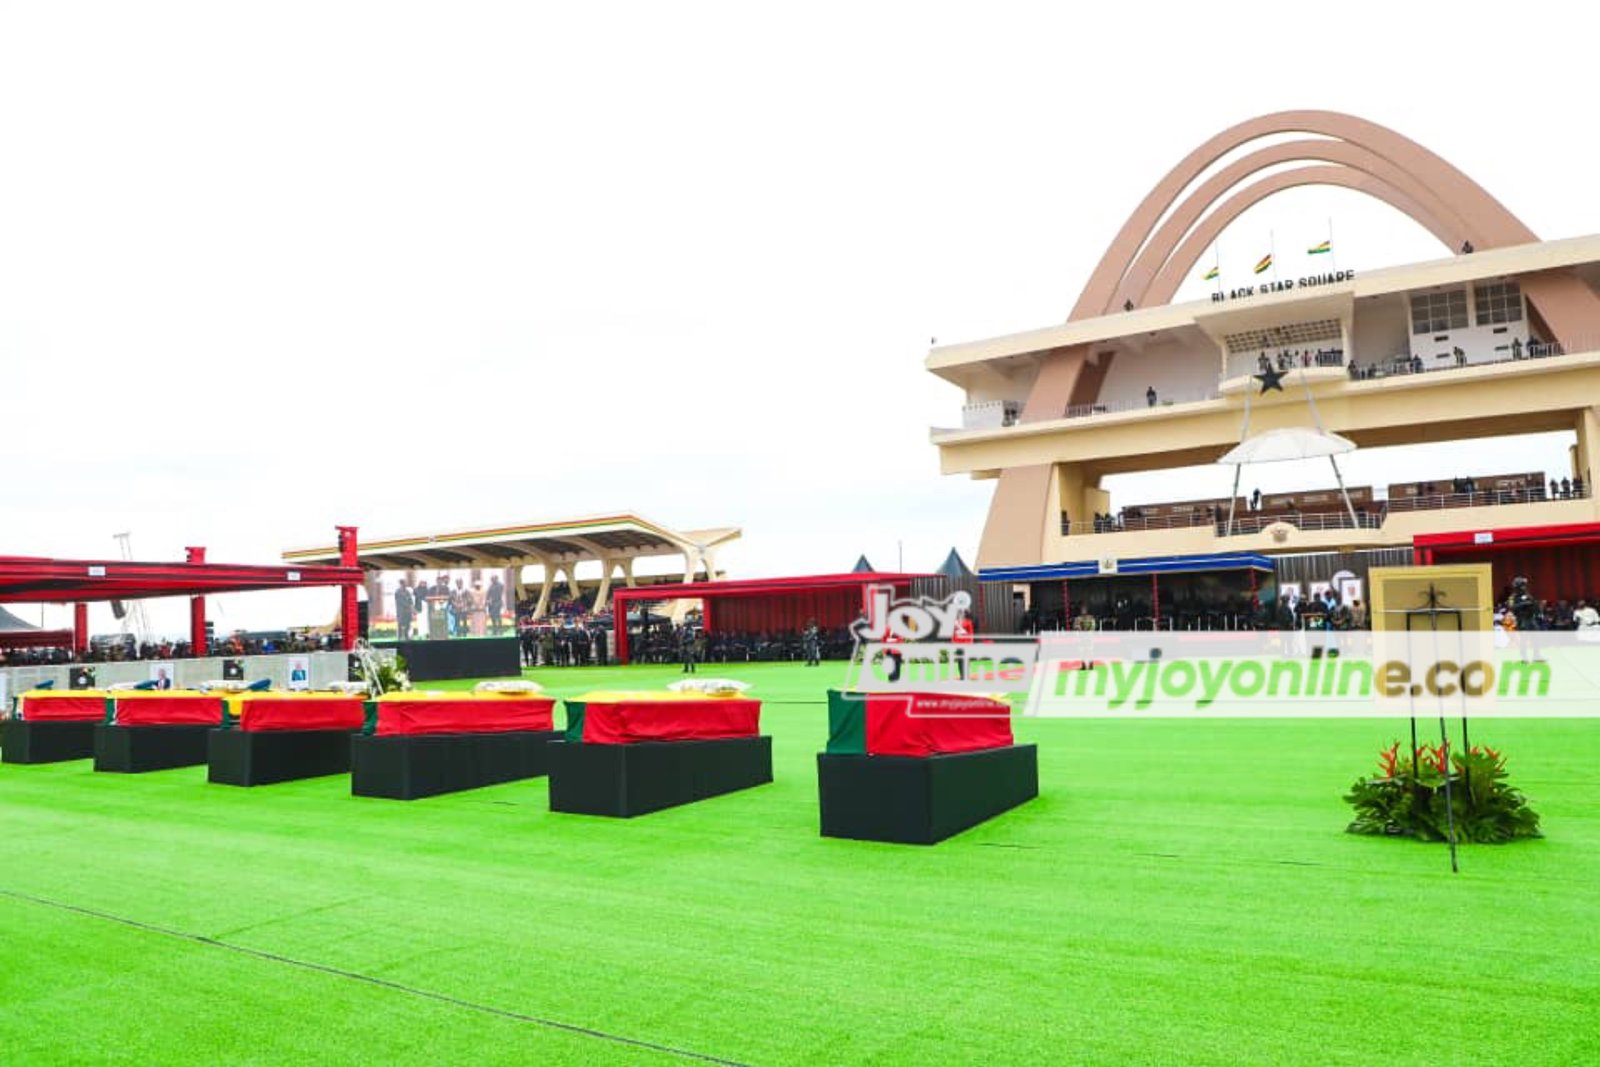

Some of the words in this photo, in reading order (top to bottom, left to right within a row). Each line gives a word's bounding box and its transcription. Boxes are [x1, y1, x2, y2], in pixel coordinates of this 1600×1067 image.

[1211, 286, 1254, 302] BLACK
[1260, 280, 1294, 294] STAR
[1299, 270, 1355, 289] SQUARE
